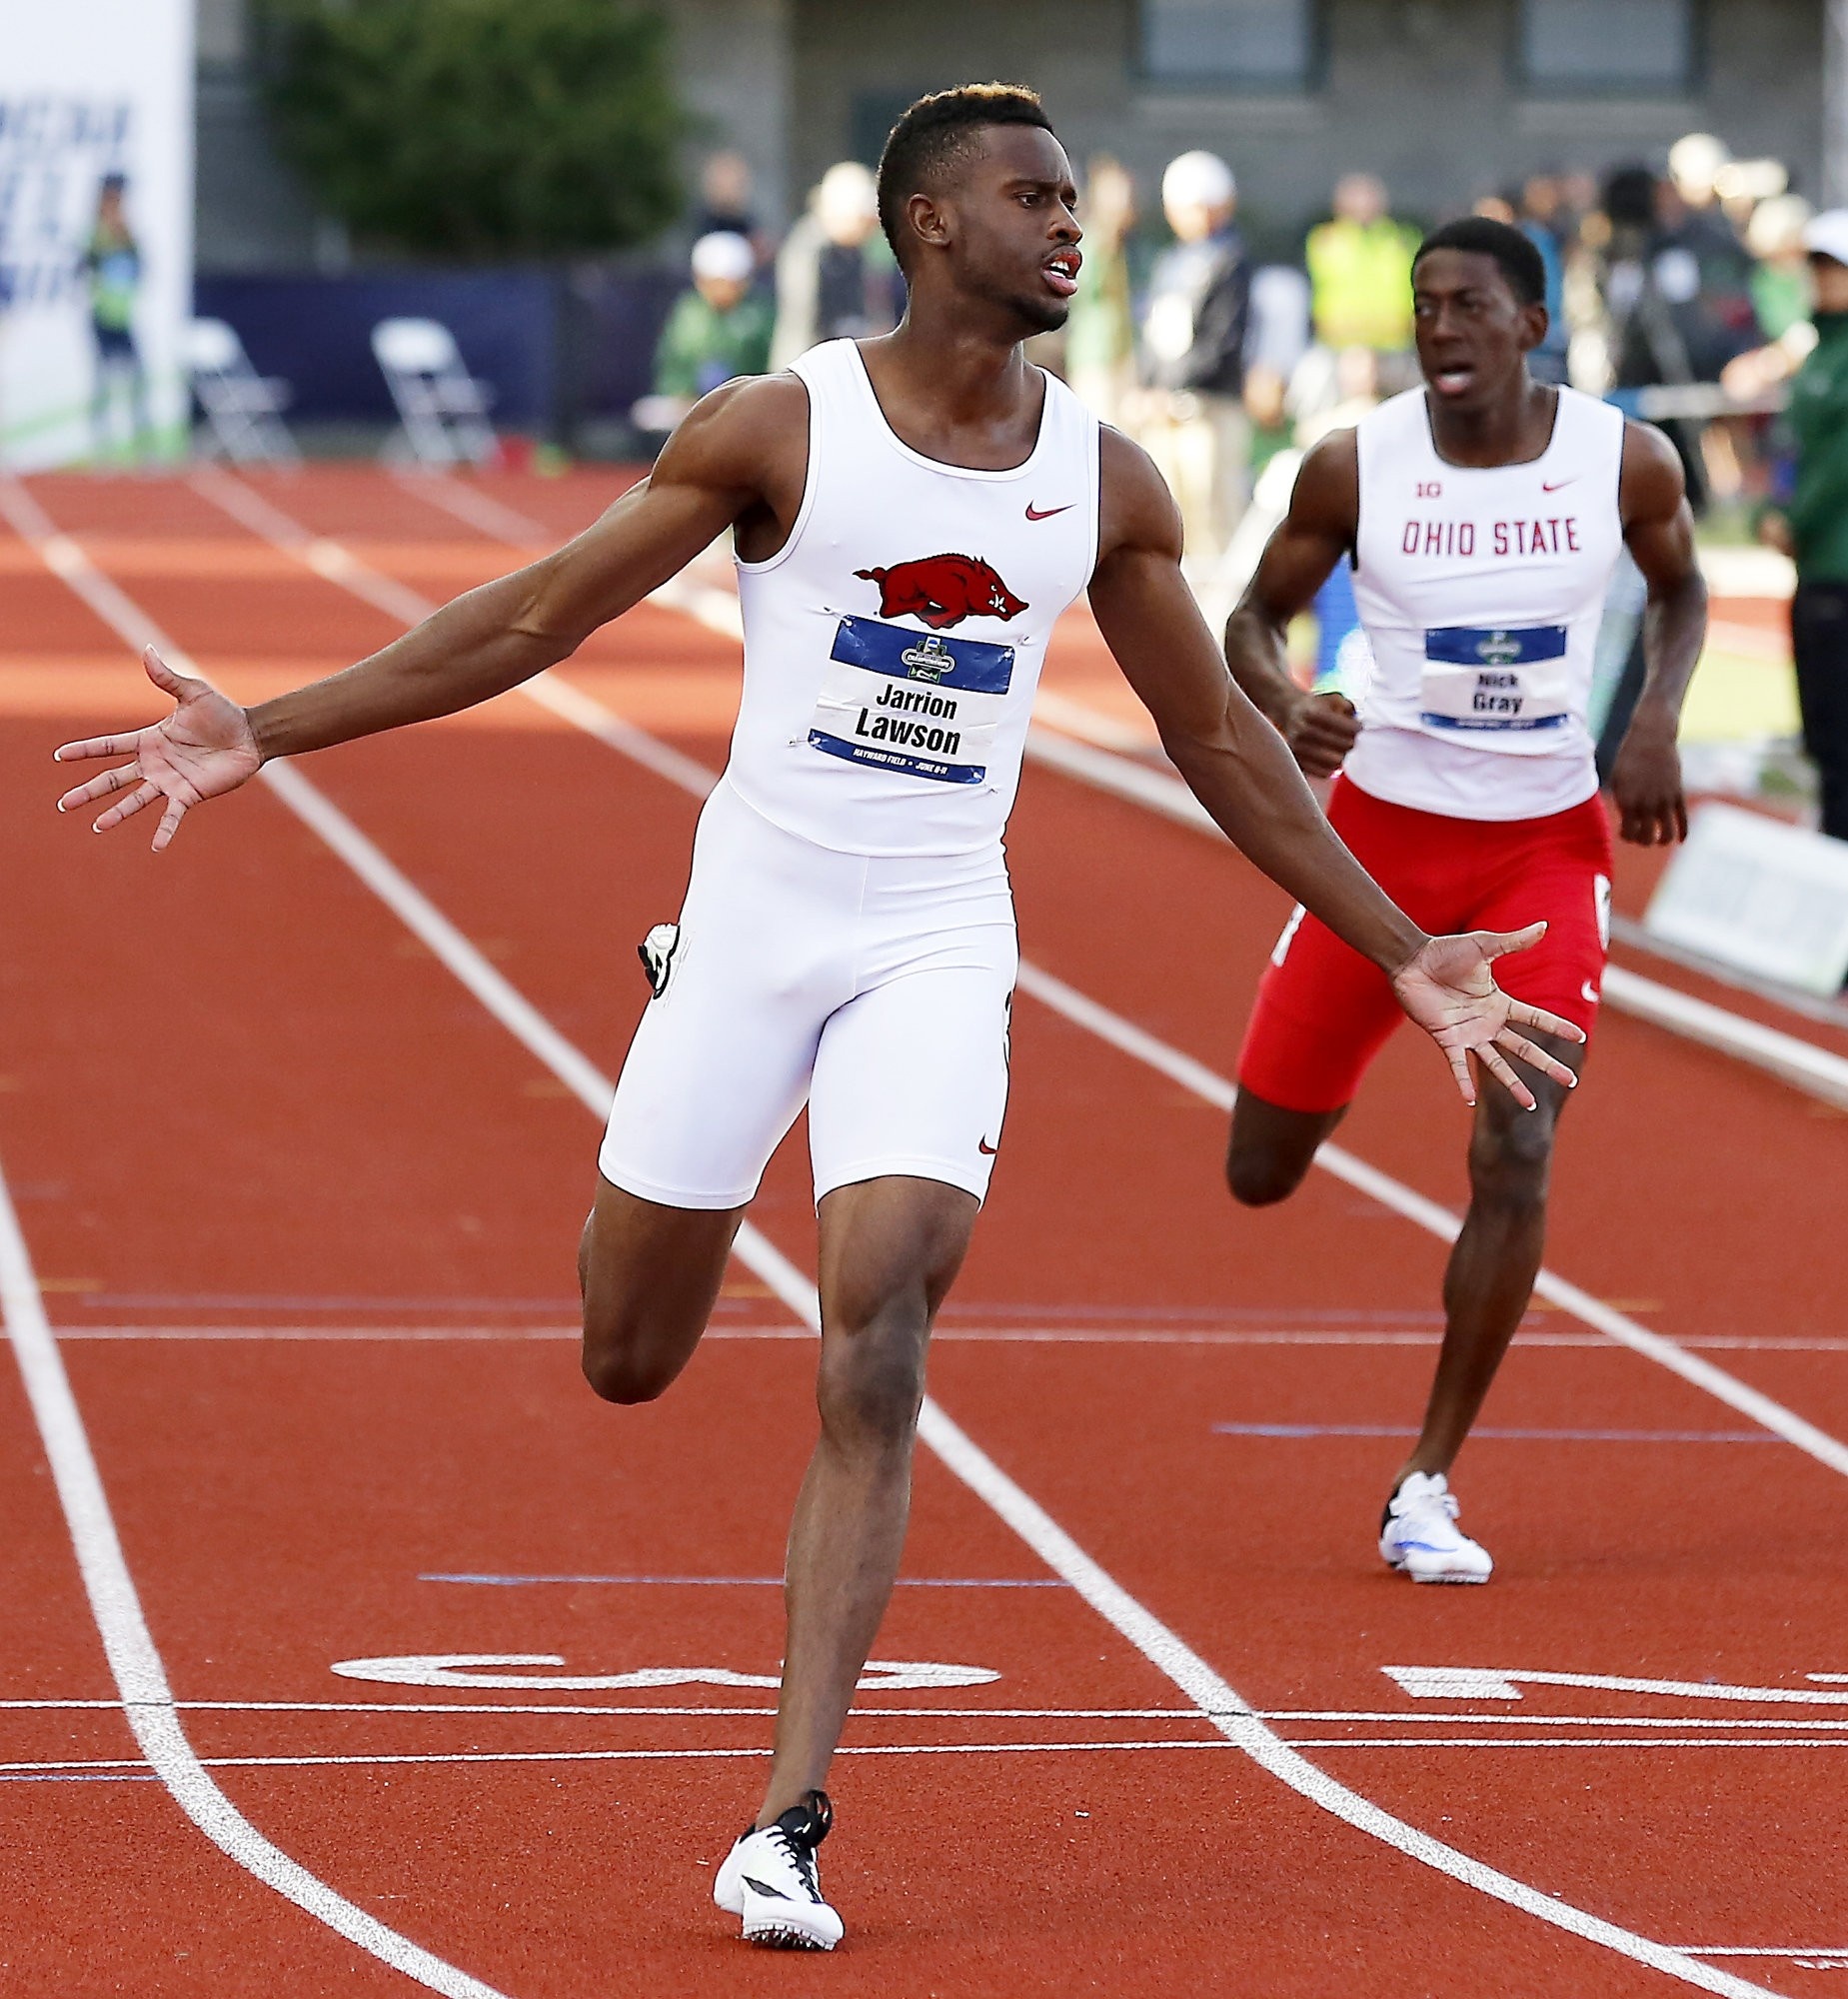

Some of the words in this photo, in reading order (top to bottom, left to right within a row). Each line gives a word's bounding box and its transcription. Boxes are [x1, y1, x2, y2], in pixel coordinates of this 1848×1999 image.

[1403, 522, 1474, 555] OHIO
[1495, 518, 1581, 555] STATE
[1478, 674, 1517, 688] Nick
[877, 684, 957, 720] Jarrion
[1473, 693, 1522, 714] Gray
[855, 708, 961, 755] Lawson
[853, 748, 888, 763] HAYWARD
[887, 756, 908, 767] FIELD
[915, 762, 934, 772] JUNE
